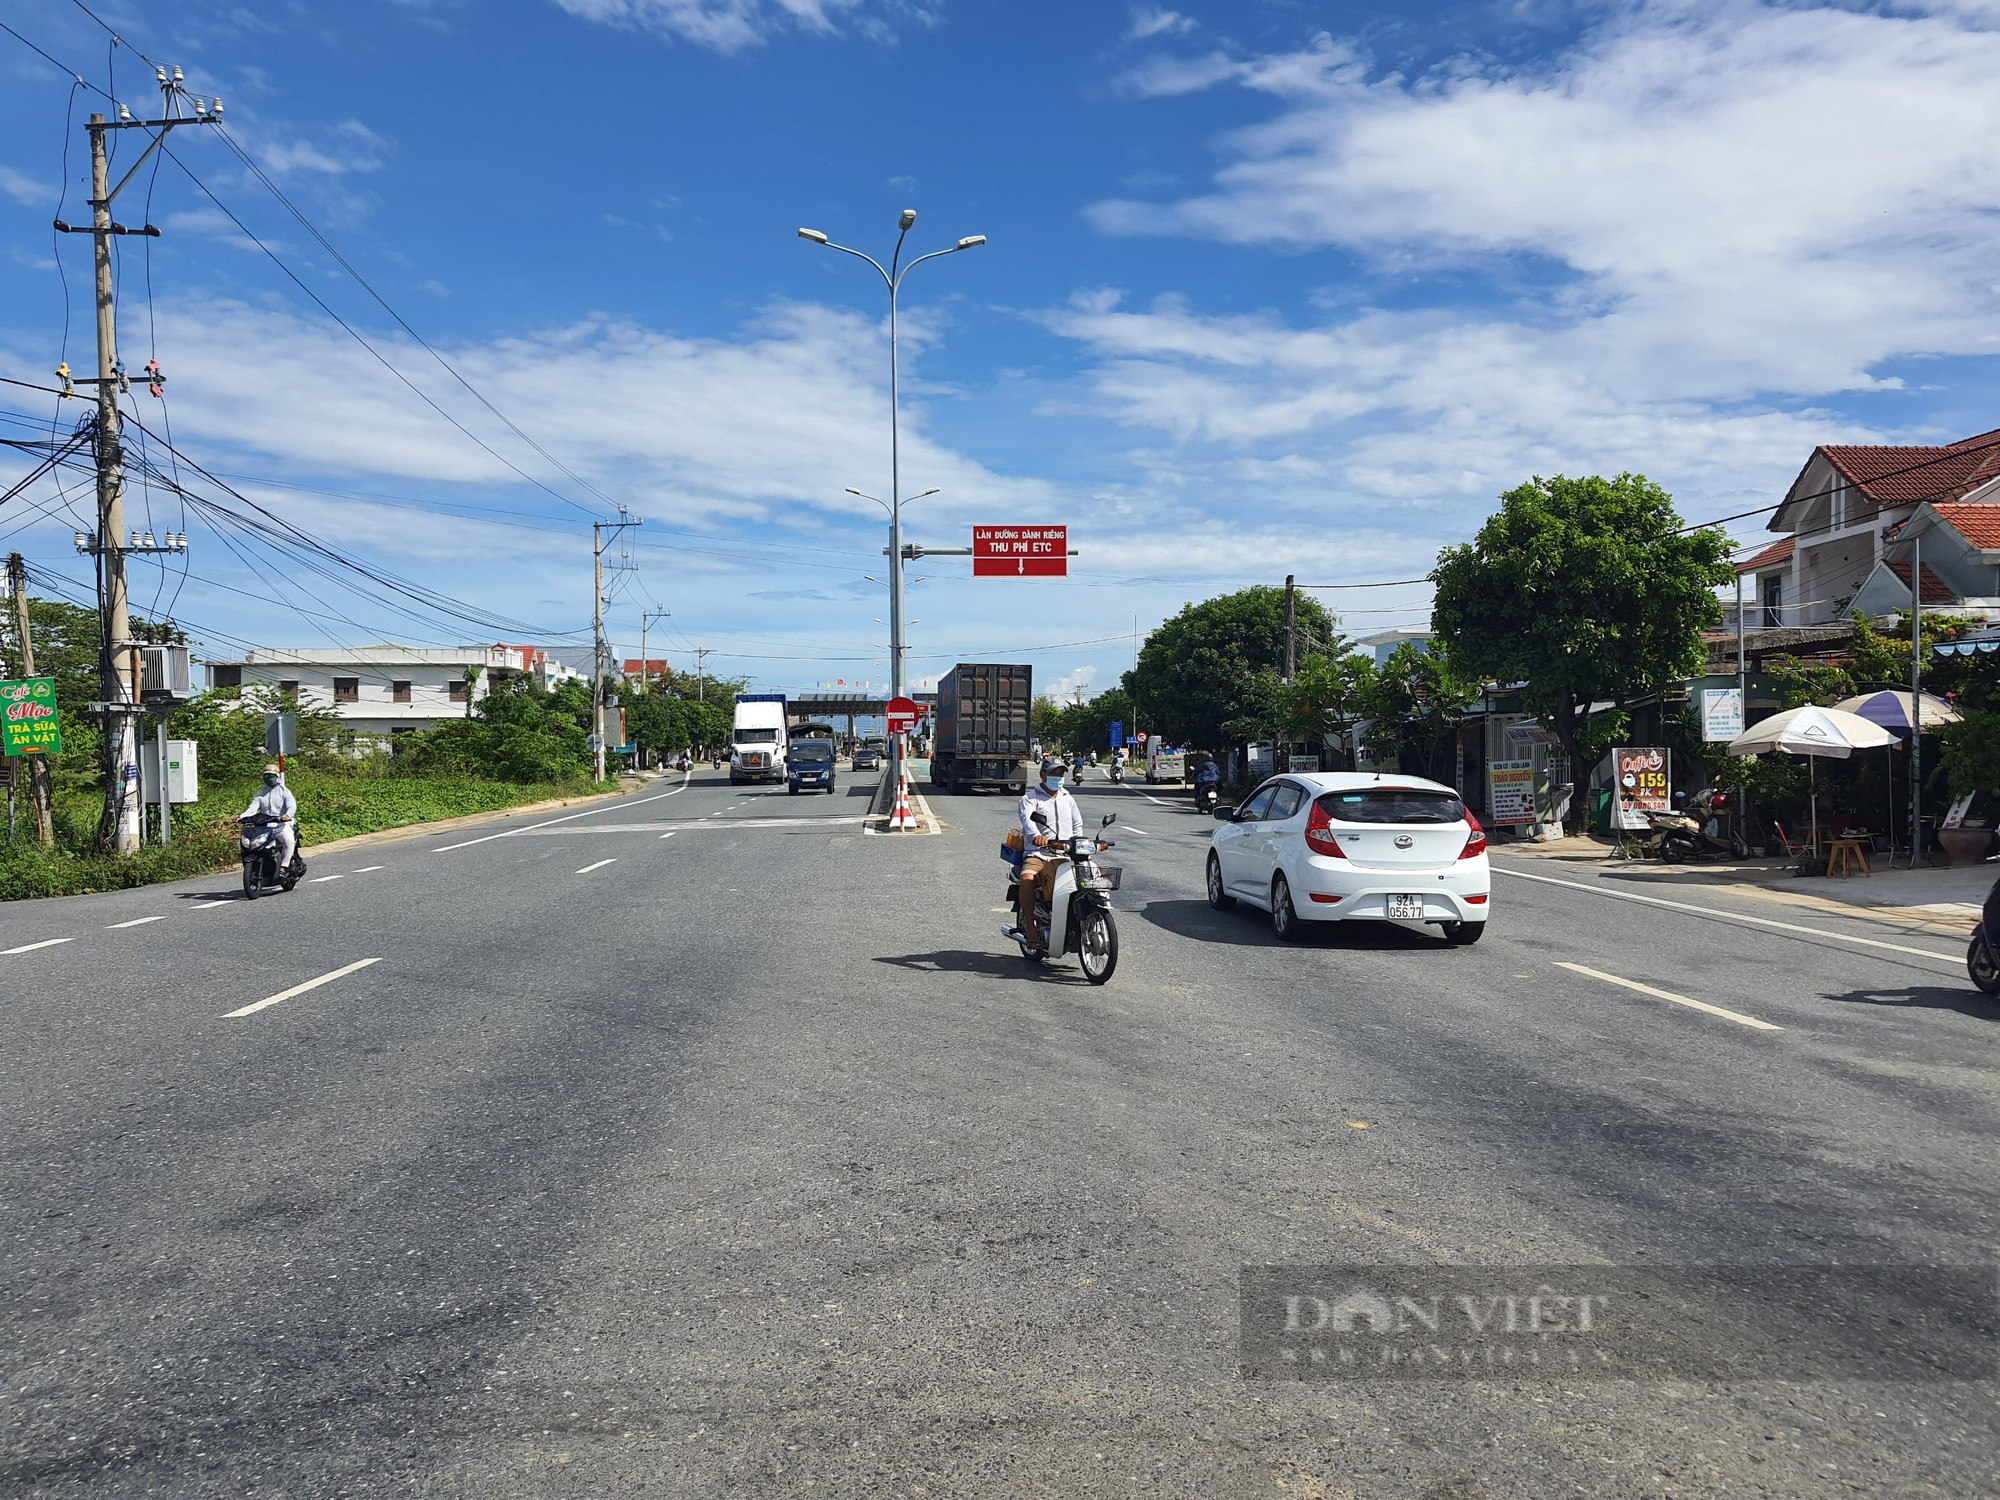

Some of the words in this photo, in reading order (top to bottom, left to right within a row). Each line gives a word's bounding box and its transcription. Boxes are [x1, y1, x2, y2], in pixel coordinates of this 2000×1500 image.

[976, 529, 991, 539] LÀN
[994, 528, 1018, 539] ĐƯỜNG
[1022, 529, 1040, 539] DÀNH
[1043, 529, 1065, 539] RIÊNG
[989, 542, 1008, 553] THU
[1013, 540, 1028, 553] PHÍ
[1032, 542, 1052, 552] ETC
[7, 701, 53, 721] Mộc
[8, 722, 31, 734] TRÀ
[33, 721, 57, 732] SỮA
[13, 734, 30, 745] ĂN
[33, 732, 56, 744] VẶT
[1290, 761, 1318, 772] PHOTOCOPY
[1622, 754, 1660, 773] Coffee
[1639, 773, 1666, 787] 159
[1396, 895, 1415, 907] 92A
[1389, 906, 1422, 918] 056.77
